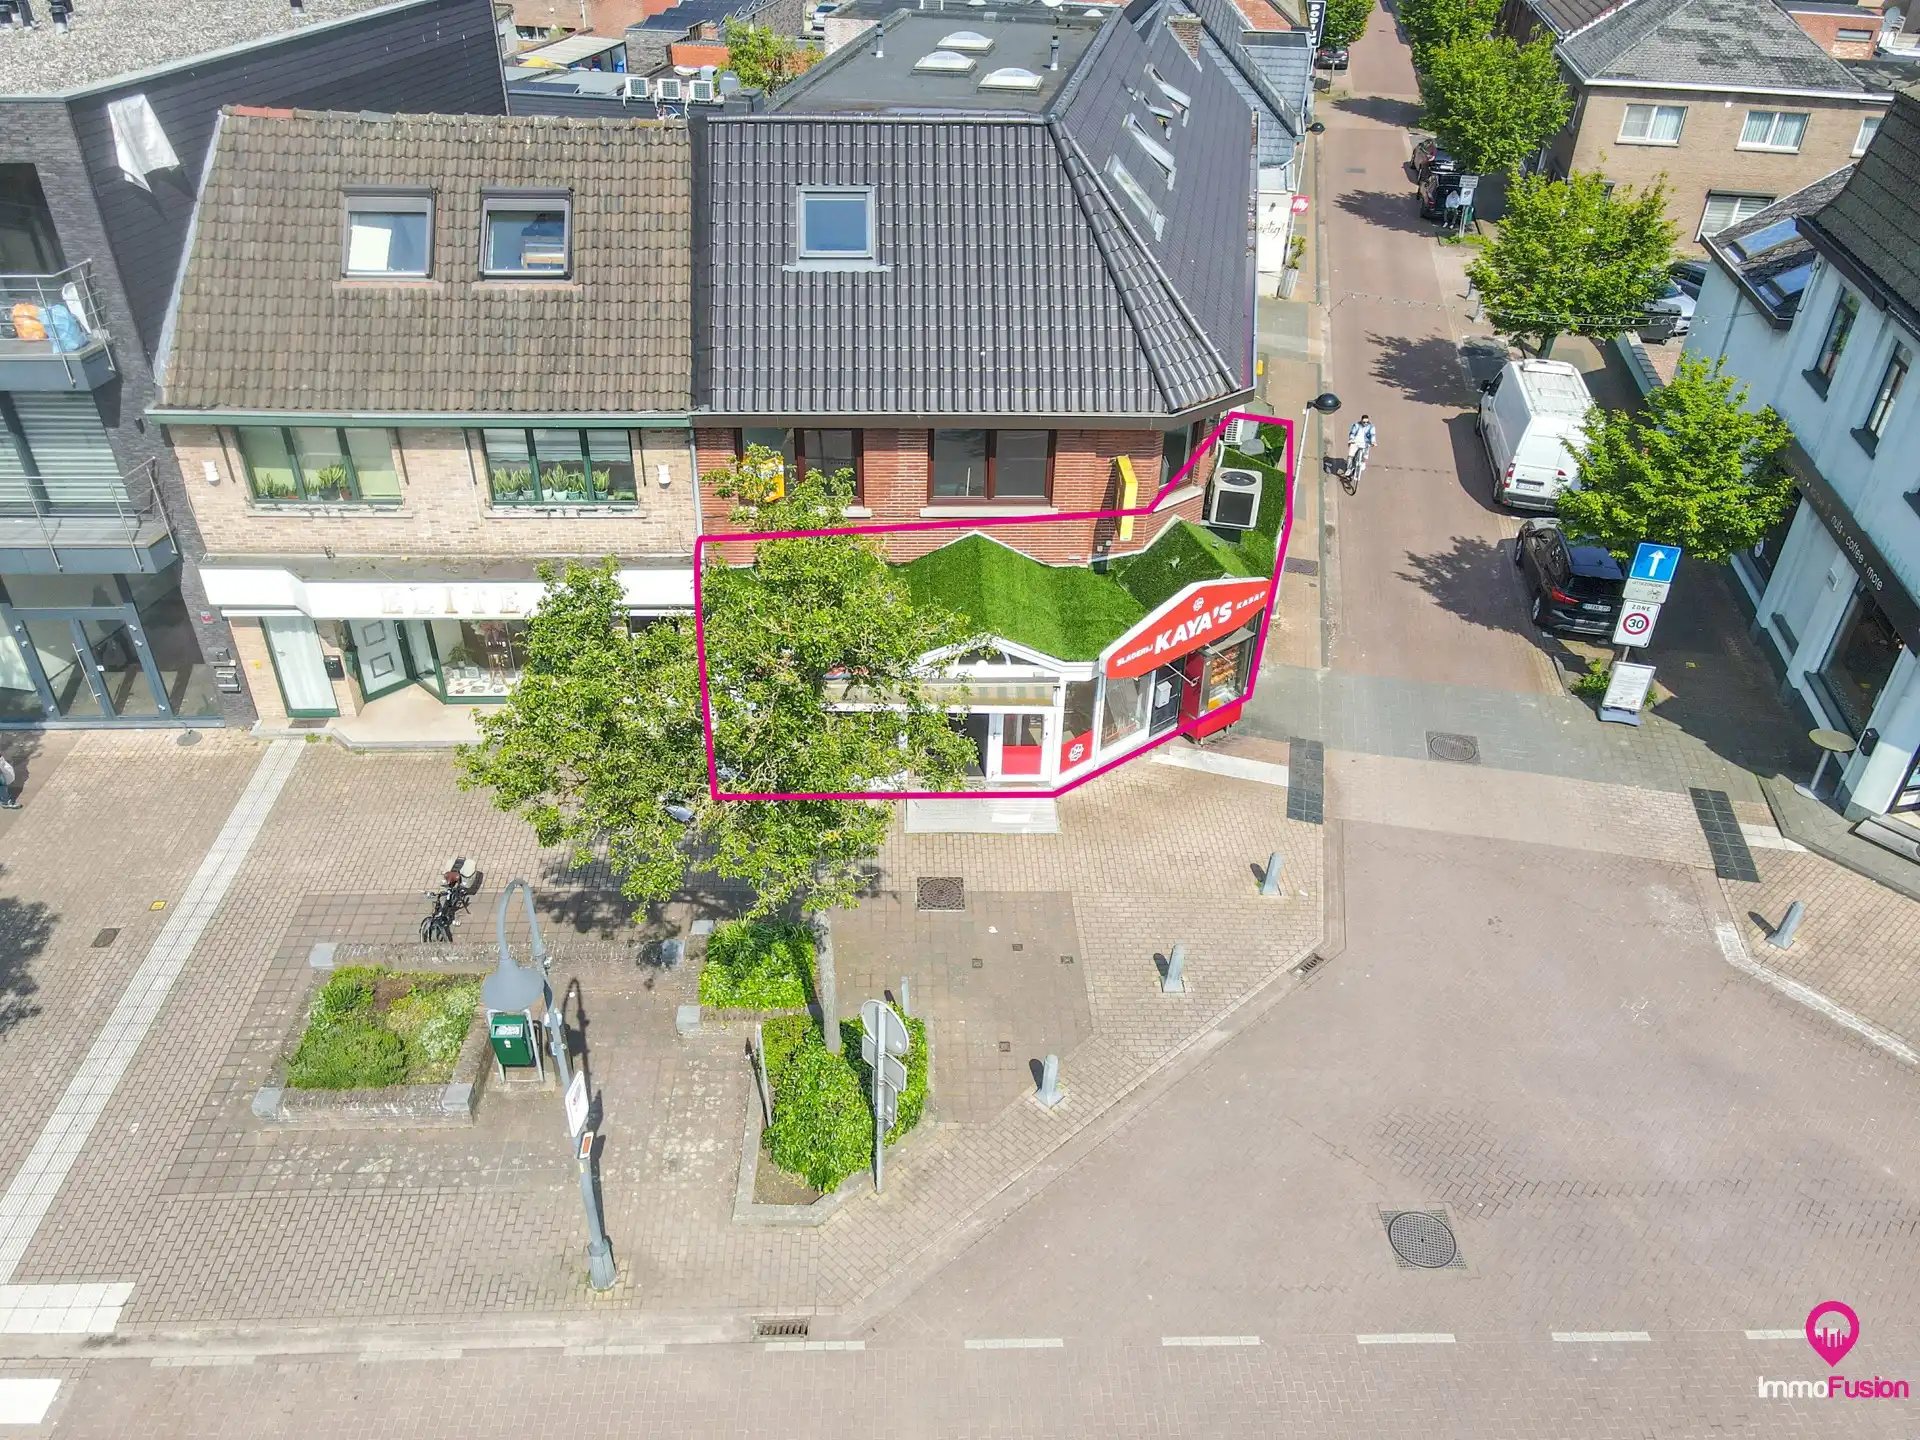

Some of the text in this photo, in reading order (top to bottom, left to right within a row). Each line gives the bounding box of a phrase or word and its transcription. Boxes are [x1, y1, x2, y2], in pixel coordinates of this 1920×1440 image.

[1845, 536, 1864, 564] coffee
[1866, 566, 1883, 591] more
[1628, 618, 1645, 630] 30
[1631, 604, 1651, 612] ZONE
[1116, 643, 1153, 667] SLAGERIJ
[1154, 601, 1233, 655] KAYA'S
